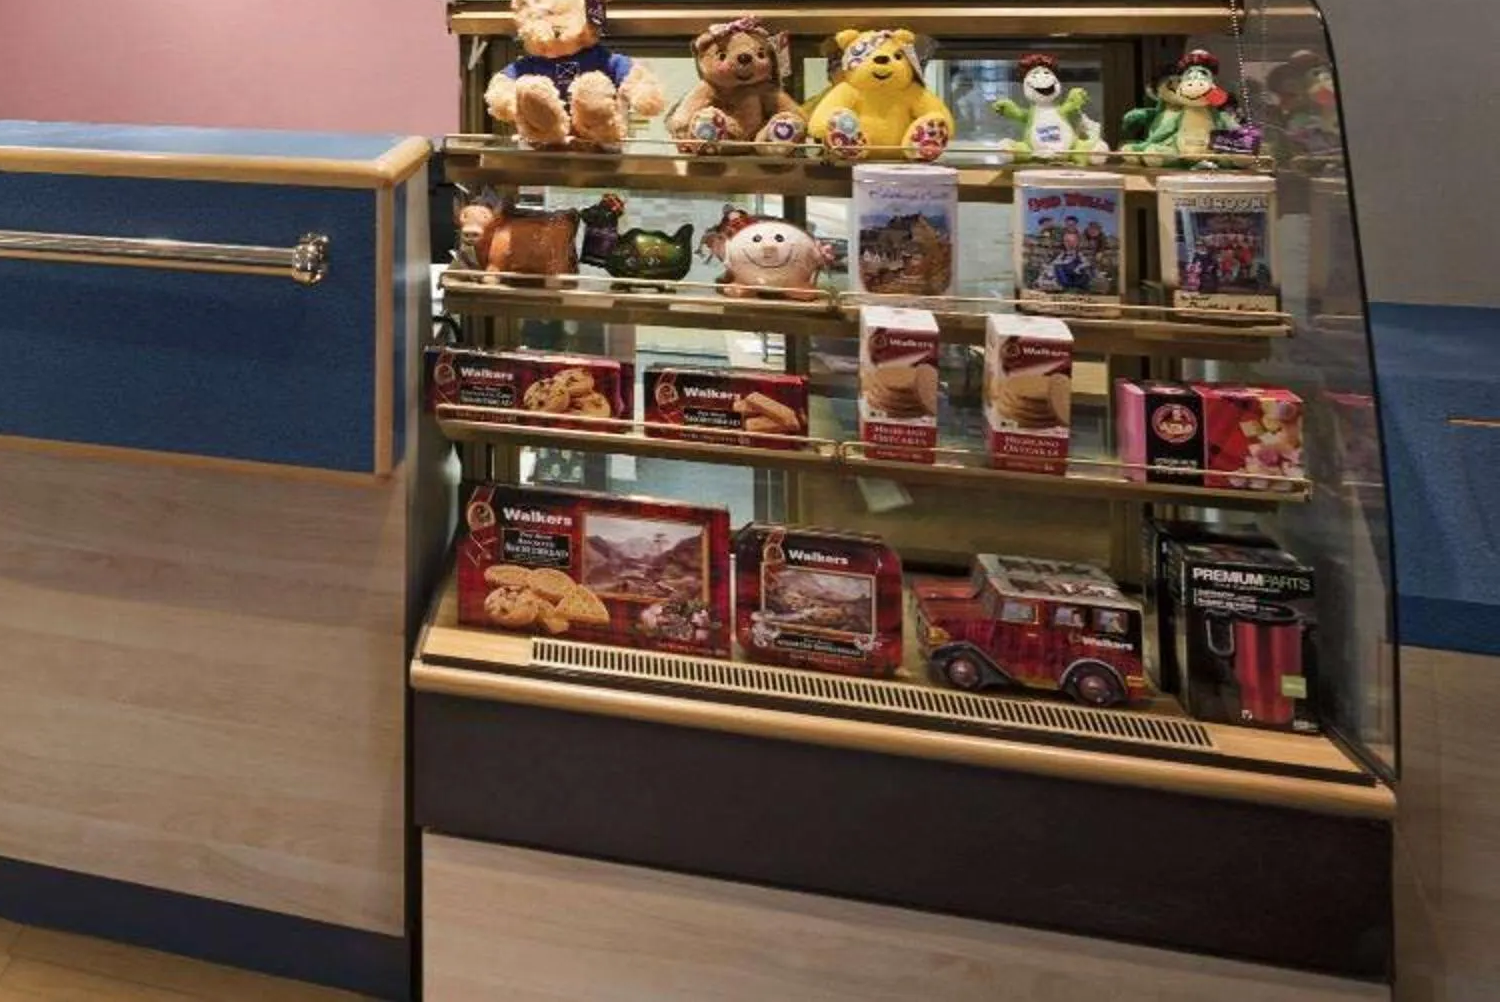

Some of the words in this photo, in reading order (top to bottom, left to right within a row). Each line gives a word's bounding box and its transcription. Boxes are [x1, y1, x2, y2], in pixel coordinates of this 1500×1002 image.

[889, 338, 934, 348] Walkers
[1023, 347, 1070, 357] Walkers
[460, 367, 514, 380] Walkers
[683, 387, 742, 400] Walkers
[503, 507, 573, 526] Walkers
[788, 550, 849, 565] Walkers
[1082, 635, 1134, 650] Walkers
